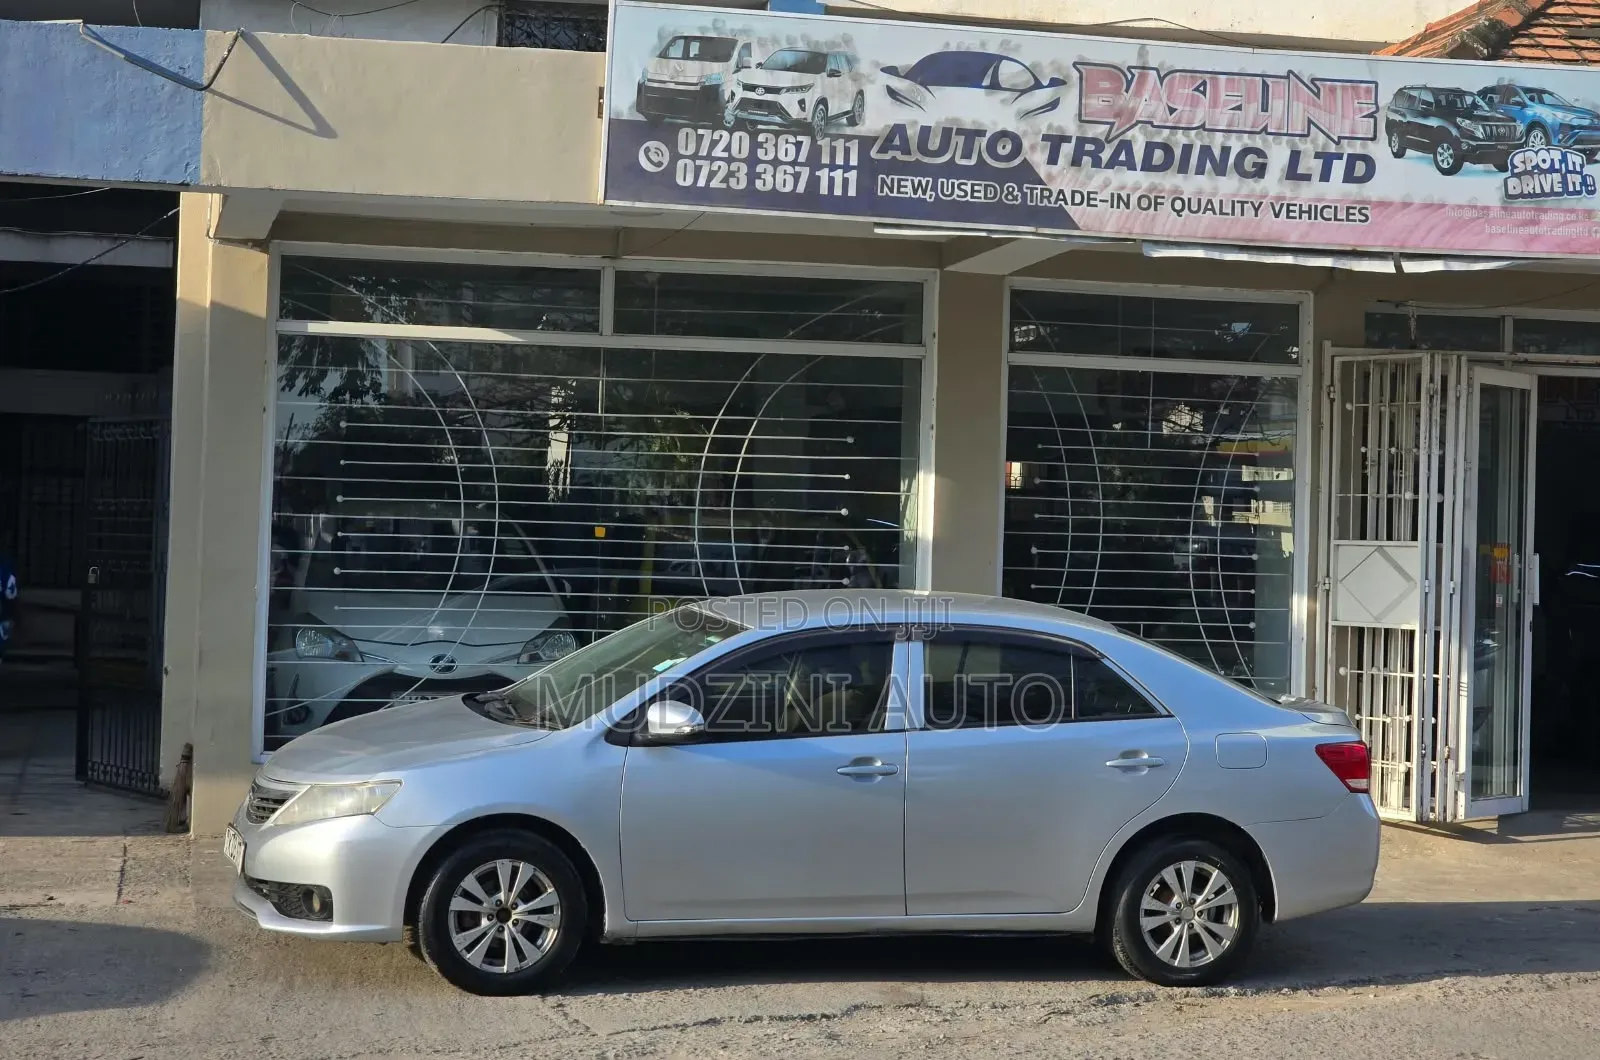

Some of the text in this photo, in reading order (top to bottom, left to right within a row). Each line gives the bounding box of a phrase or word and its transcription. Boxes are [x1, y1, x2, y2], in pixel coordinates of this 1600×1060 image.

[678, 127, 859, 166] 0720 367 111
[873, 123, 1378, 185] AUTO TRADING LTD
[1513, 150, 1583, 173] SPOT IT
[675, 158, 858, 197] 0723 367 111
[1507, 174, 1563, 195] DRIVE
[1567, 173, 1582, 192] IT
[878, 175, 1370, 224] NEW, USED & TRADE-IN OF QUALITY VEHICLES
